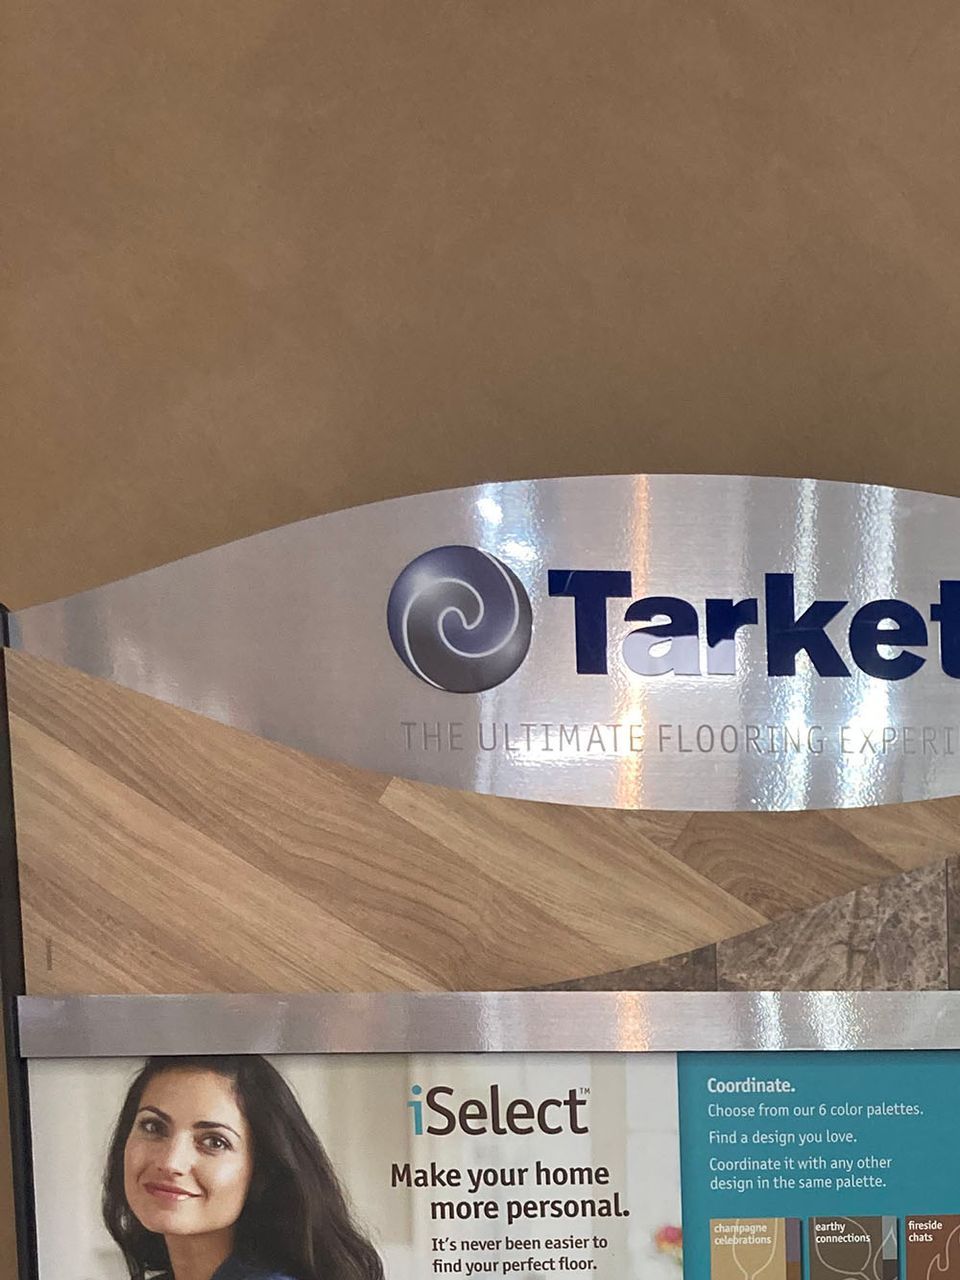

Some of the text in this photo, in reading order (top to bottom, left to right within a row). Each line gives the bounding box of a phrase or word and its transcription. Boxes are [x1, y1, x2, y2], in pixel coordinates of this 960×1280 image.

[401, 721, 465, 752] THE
[478, 721, 644, 754] ULTIMATE
[658, 724, 825, 755] FLOORING
[708, 1077, 795, 1093] Coordinate.
[708, 1102, 923, 1118] Choose from our 6 color palettes.
[710, 1130, 856, 1146] Find a design you love.
[710, 1156, 892, 1172] Coordinate it with any other
[392, 1161, 609, 1193] Make your home
[710, 1175, 886, 1192] design in the same palette.
[431, 1192, 629, 1225] more personal.
[714, 1223, 767, 1235] champagne
[815, 1221, 846, 1234] earthy
[908, 1220, 942, 1231] fireside
[432, 1235, 607, 1251] It's never been easier to
[714, 1233, 771, 1245] celebrations
[815, 1232, 870, 1244] connections
[908, 1232, 933, 1242] chats
[432, 1257, 597, 1276] find your perfect floor.
